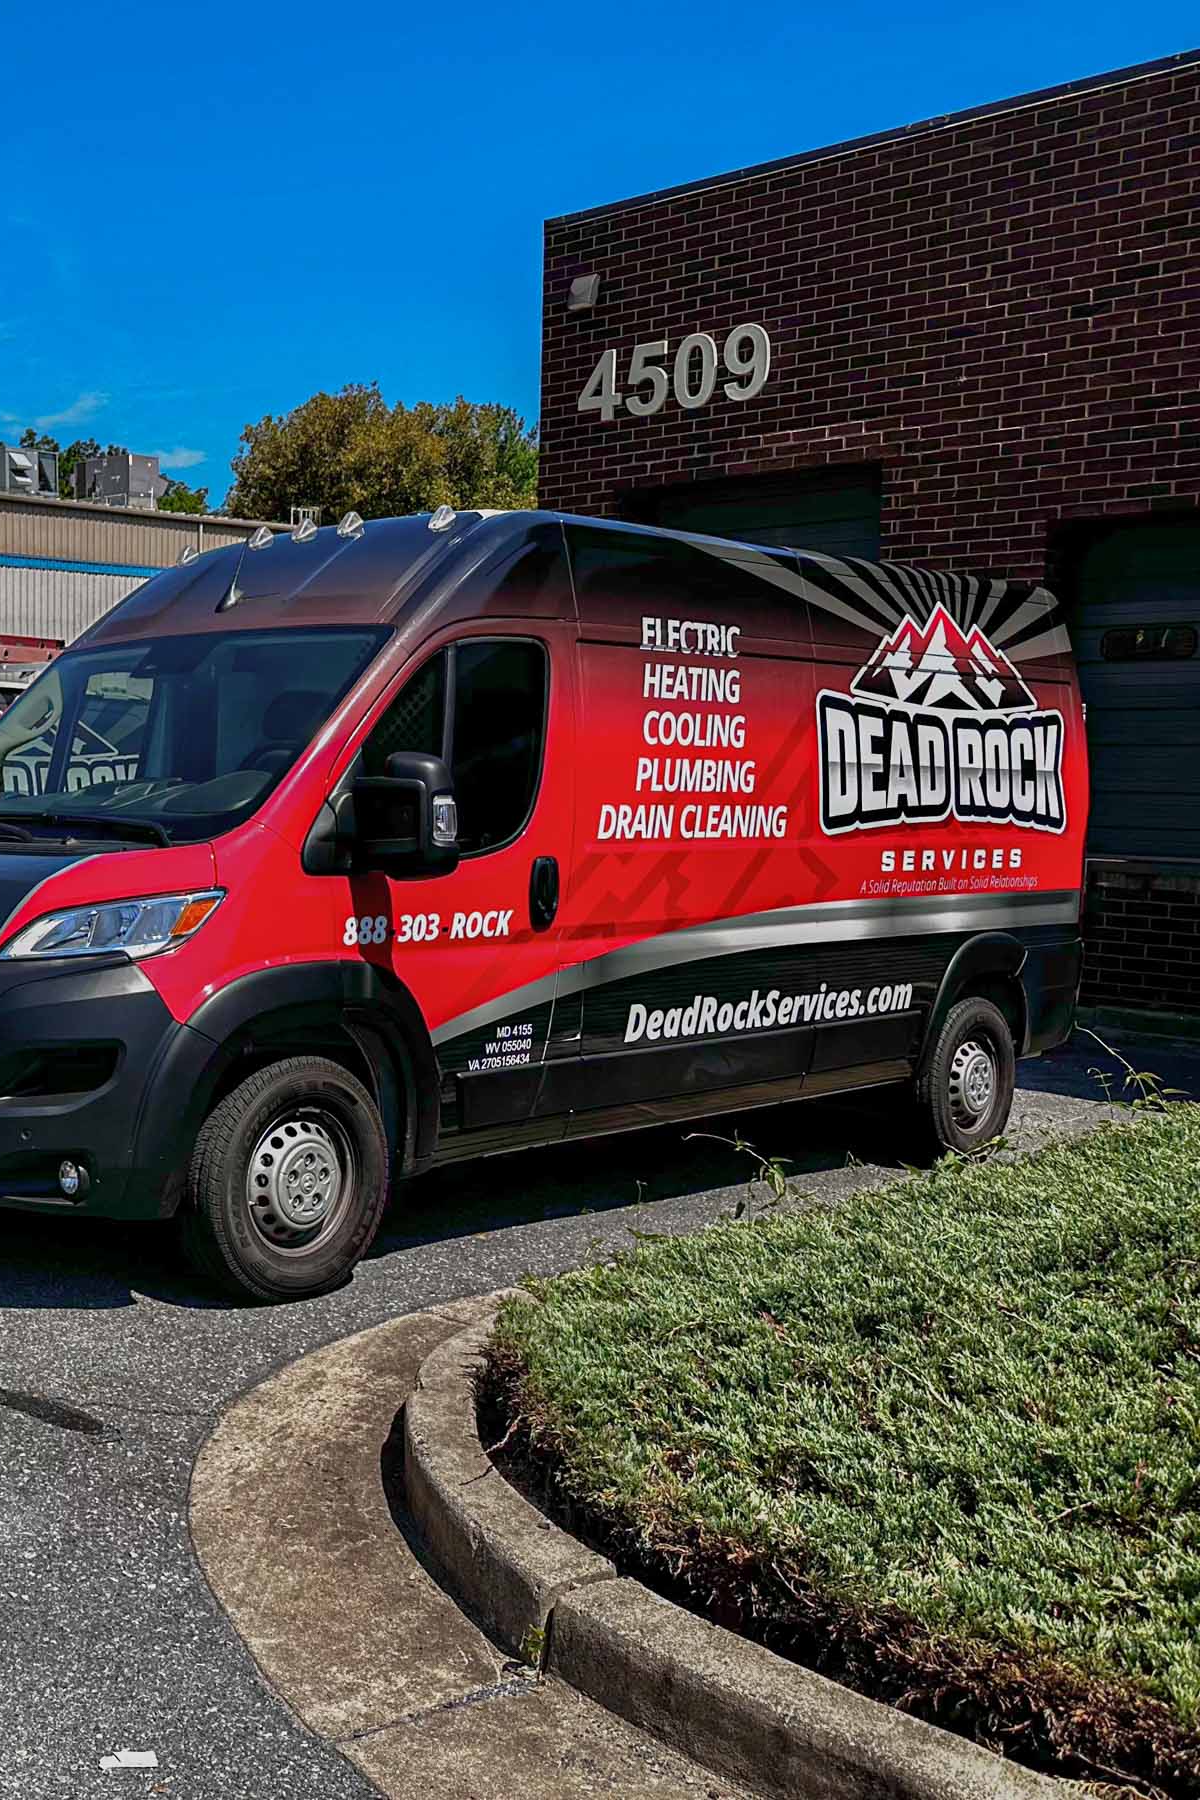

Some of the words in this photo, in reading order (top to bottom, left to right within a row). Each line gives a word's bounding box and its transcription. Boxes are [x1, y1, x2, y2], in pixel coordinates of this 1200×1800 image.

[577, 323, 771, 421] 4509
[640, 616, 741, 658] ELECTRIC
[642, 663, 741, 704] HEATING
[642, 710, 746, 748] COOLING
[635, 757, 756, 794] PLUMBING
[825, 705, 947, 818] DEAD
[956, 723, 1061, 819] ROCK
[596, 804, 675, 840] DRAIN
[679, 804, 788, 839] CLEANING
[880, 848, 1023, 873] SERVICES
[859, 879, 867, 895] A
[868, 877, 890, 894] Solid
[891, 877, 937, 897] Reputation
[938, 876, 957, 892] Built
[957, 879, 968, 890] on
[969, 875, 990, 890] Solid
[990, 874, 1039, 891] Relationships
[496, 1026, 511, 1039] MD
[512, 1023, 533, 1037] 4155
[623, 982, 913, 1043] DeadRockServices.com
[468, 1059, 480, 1071] VA
[480, 1052, 530, 1070] 2705156434
[485, 1041, 501, 1055] WV
[501, 1038, 532, 1053] 055040
